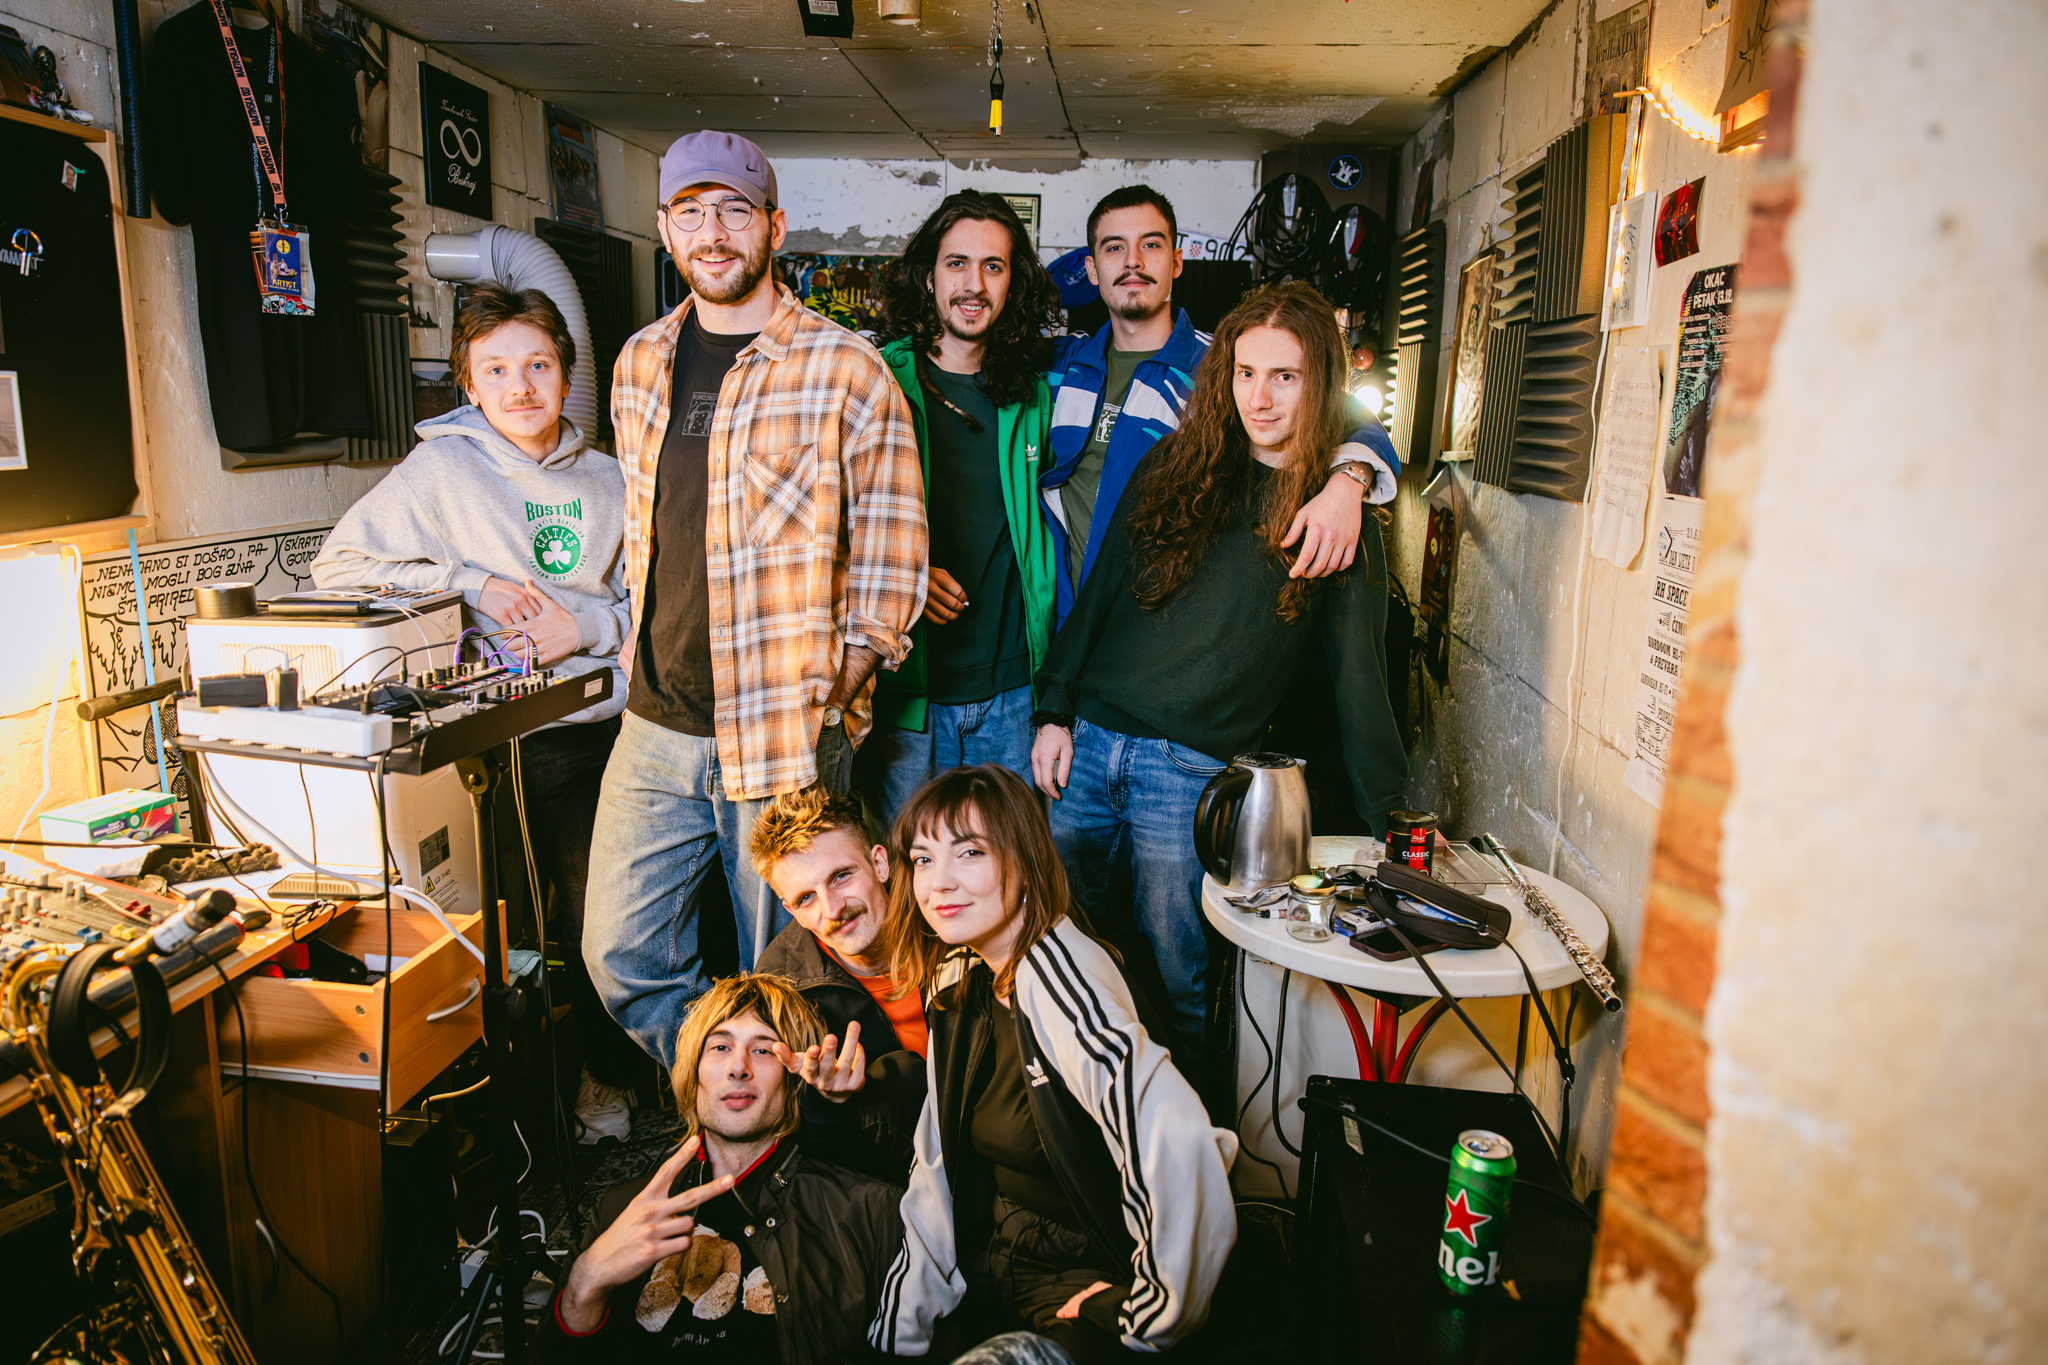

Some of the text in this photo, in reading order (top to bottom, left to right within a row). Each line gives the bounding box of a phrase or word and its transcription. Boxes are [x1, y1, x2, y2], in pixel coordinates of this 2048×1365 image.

[272, 279, 296, 289] ARTIST
[1693, 292, 1716, 309] PETAK
[524, 497, 582, 522] BOSTON
[285, 535, 324, 551] SKRATI
[535, 527, 579, 548] CELTICS
[247, 543, 268, 557] PA
[287, 550, 320, 566] GOVO
[145, 571, 191, 590] MOGLI
[196, 565, 222, 582] BOG
[1655, 580, 1690, 607] RH SPACE
[1402, 850, 1430, 858] CLASSIC
